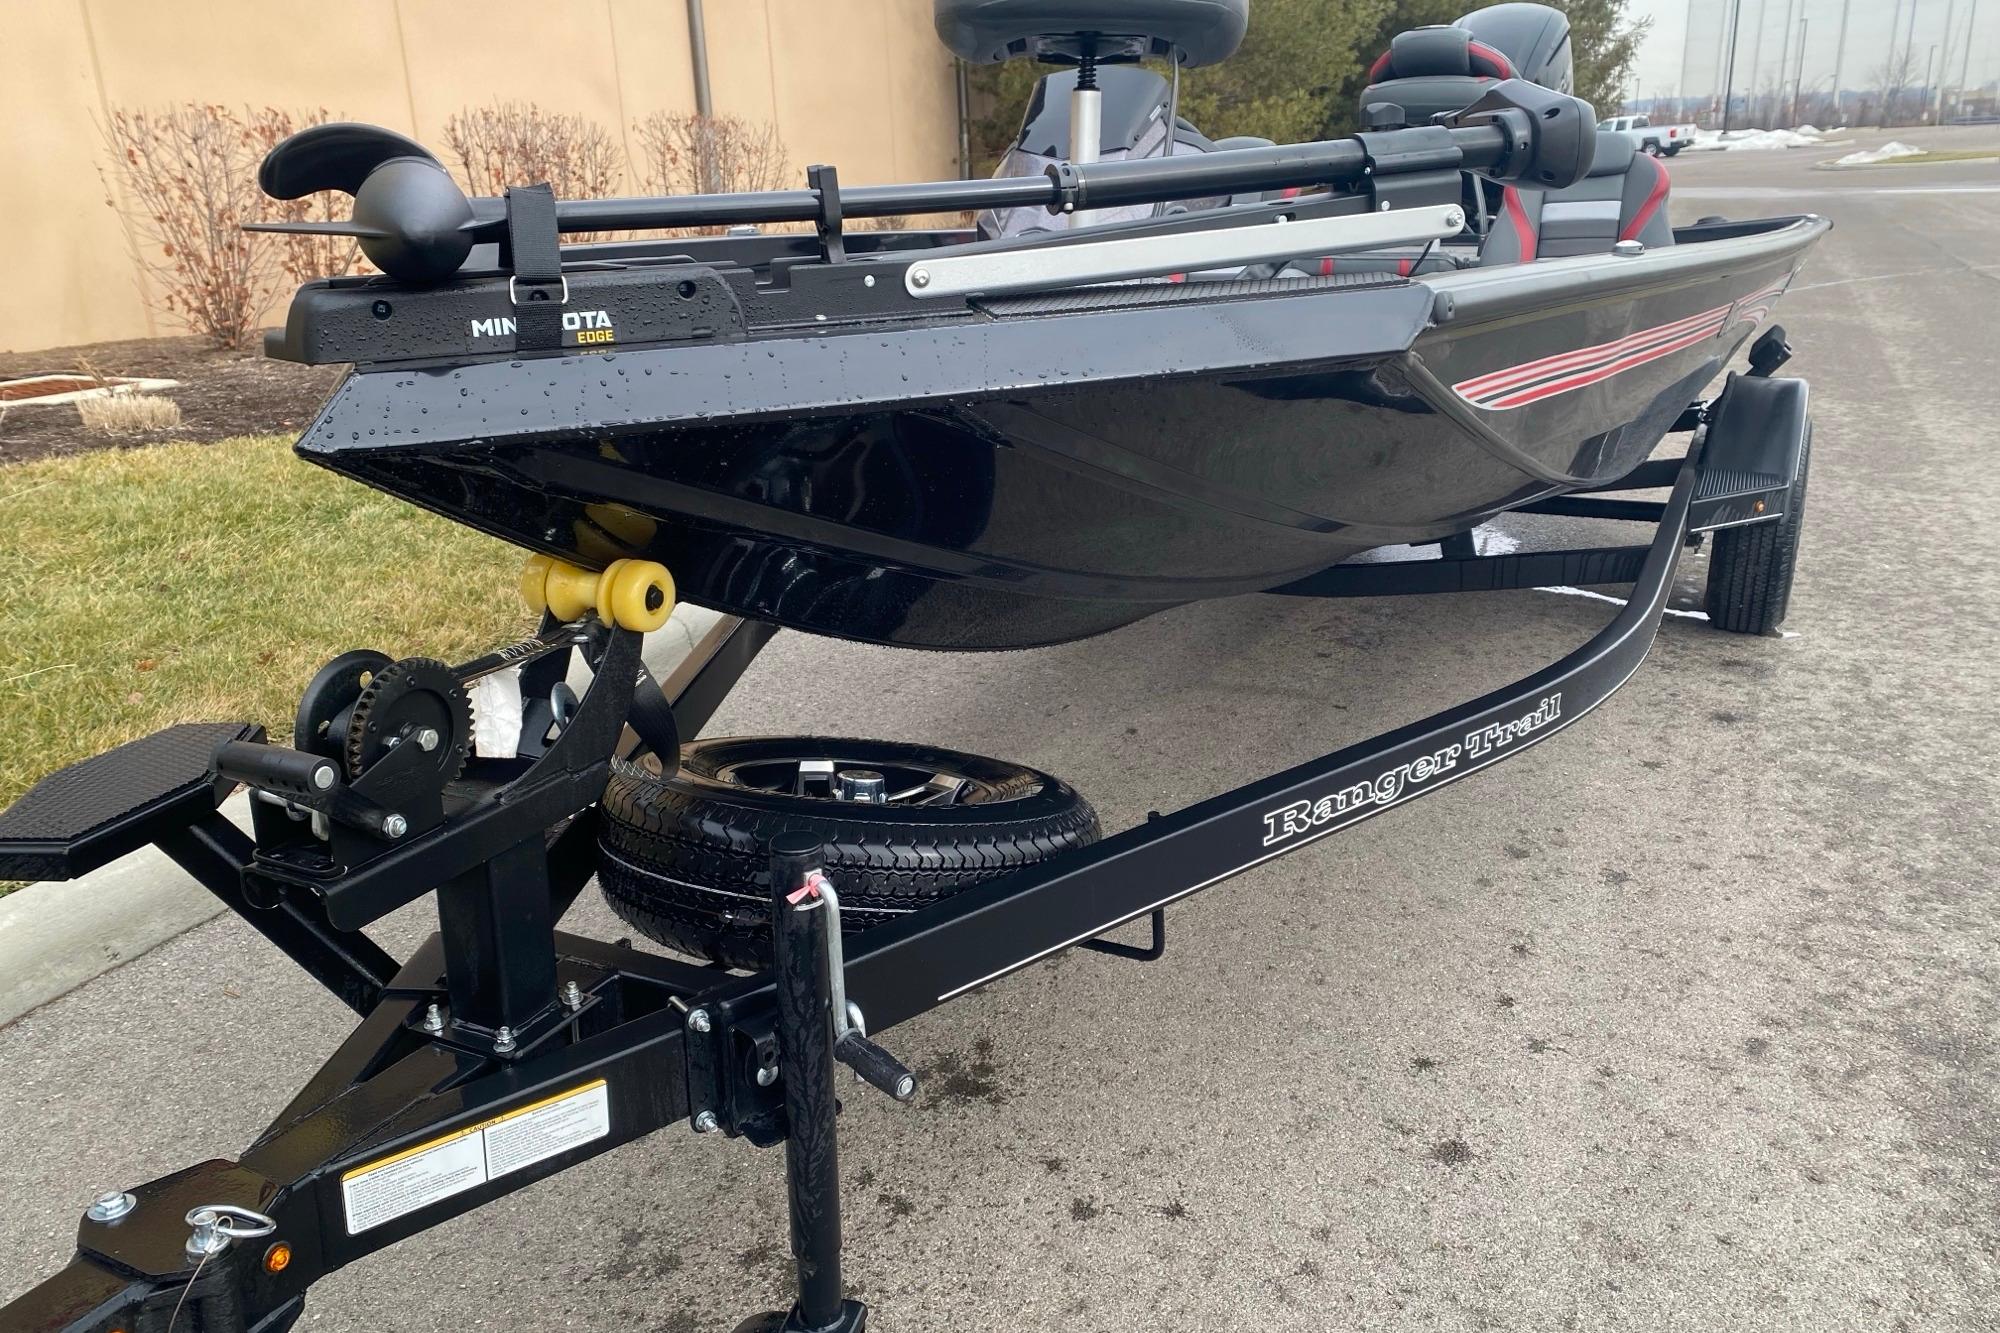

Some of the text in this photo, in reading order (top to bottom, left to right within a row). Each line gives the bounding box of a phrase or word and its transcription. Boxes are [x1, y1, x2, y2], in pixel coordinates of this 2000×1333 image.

[471, 310, 613, 338] MIN OTA
[577, 329, 615, 344] EDGE
[1262, 692, 1562, 847] Ranger Trail
[469, 1120, 496, 1133] CAUTION
